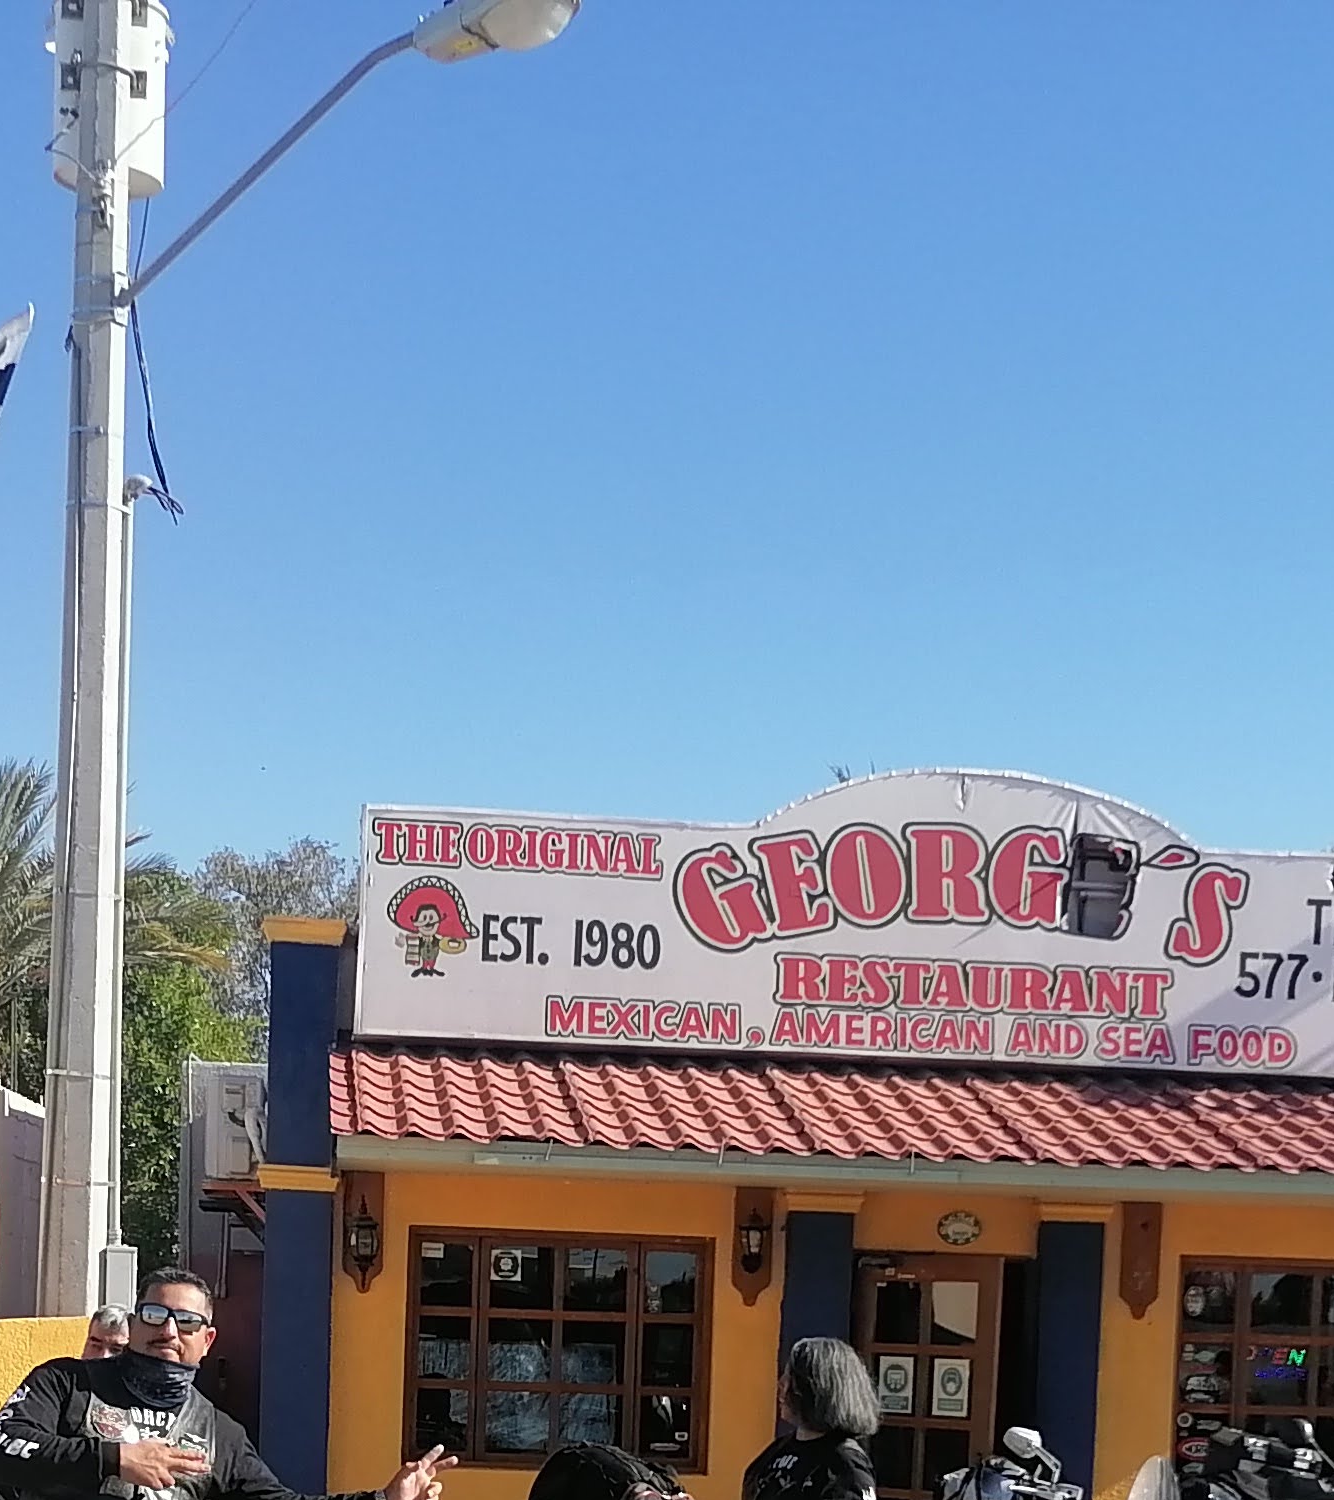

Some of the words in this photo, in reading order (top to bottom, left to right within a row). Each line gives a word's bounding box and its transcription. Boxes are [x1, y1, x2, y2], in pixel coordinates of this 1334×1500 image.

[373, 817, 462, 868] THE
[464, 822, 663, 881] ORIGINAL
[673, 822, 1250, 967] GEORG'S
[480, 913, 550, 966] EST.
[572, 919, 662, 970] 1980
[773, 952, 1175, 1019] RESTAURANT
[545, 995, 766, 1049] MEXICAN,
[768, 1006, 995, 1054] AMERICAN
[1007, 1017, 1089, 1059] AND
[1096, 1021, 1175, 1065] SEA
[1186, 1023, 1302, 1069] FOOD
